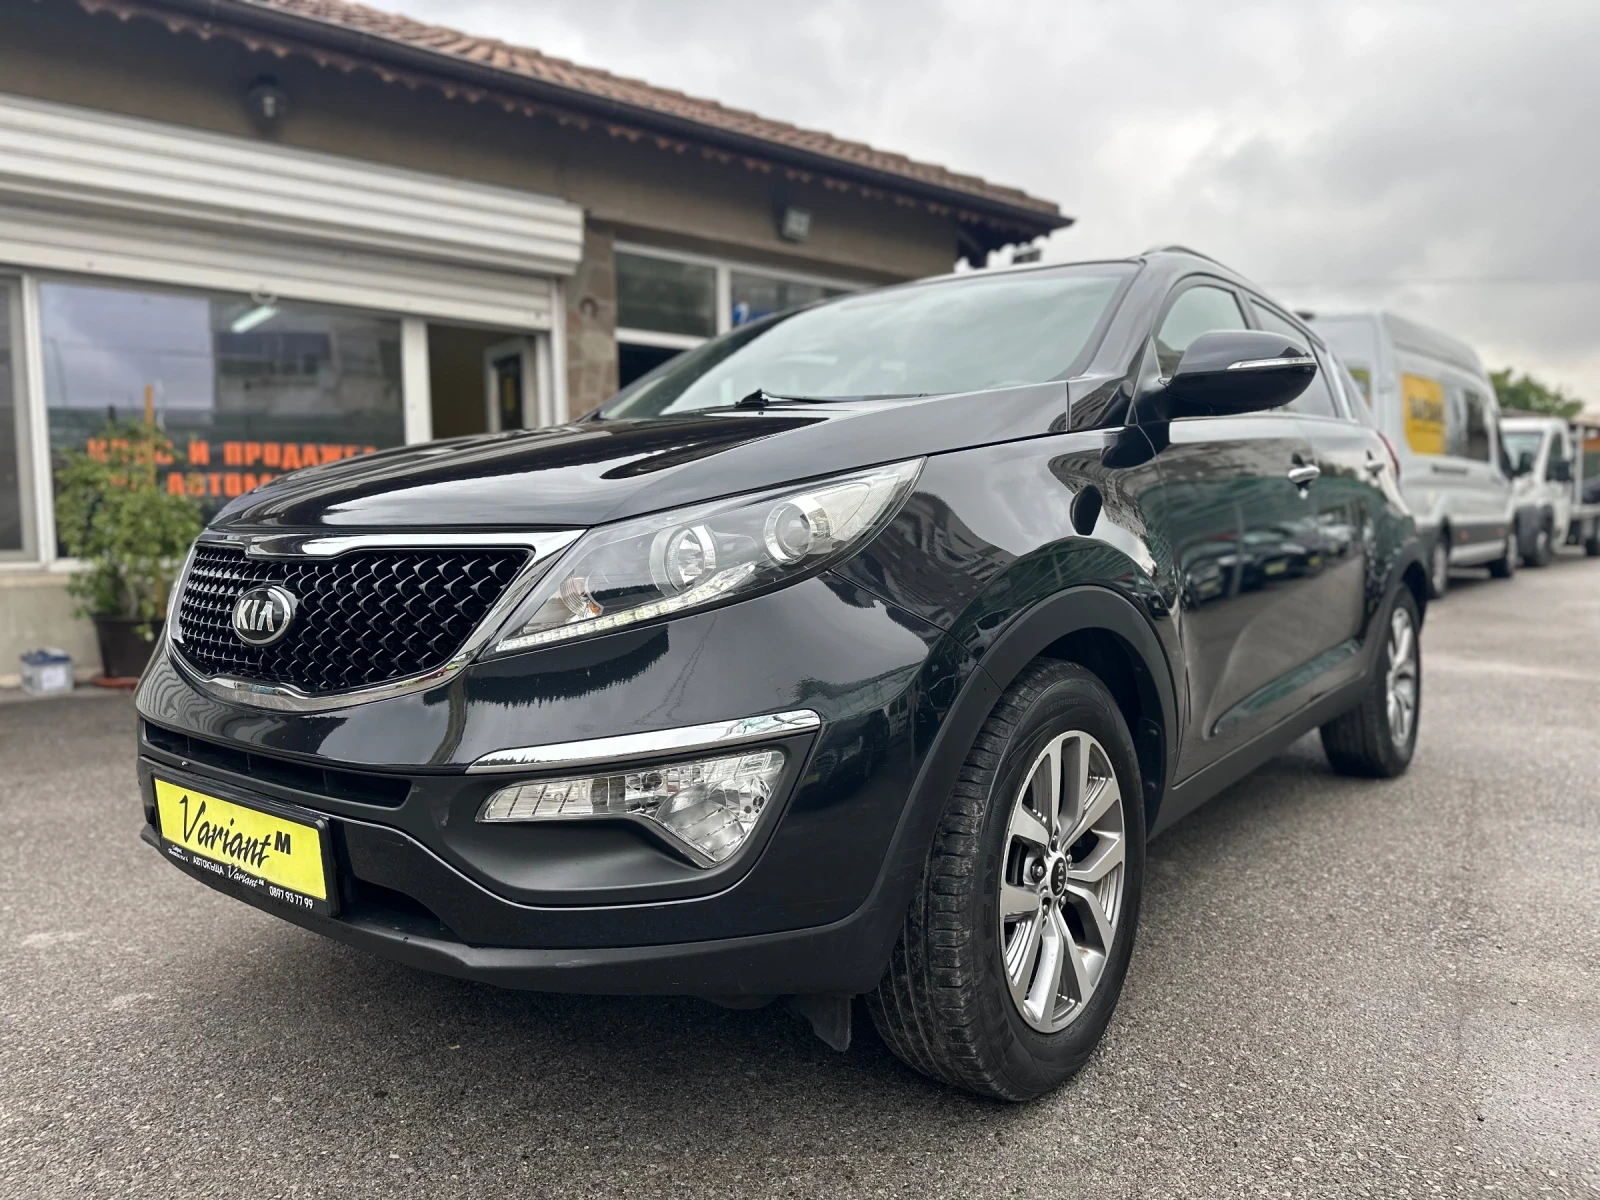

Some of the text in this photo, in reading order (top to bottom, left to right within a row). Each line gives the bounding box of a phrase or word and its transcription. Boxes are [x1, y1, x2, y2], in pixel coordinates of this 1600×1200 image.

[236, 599, 275, 632] KIA
[179, 794, 271, 868] Variant
[1056, 862, 1065, 892] KIA
[269, 885, 284, 899] 0897
[285, 891, 294, 903] 93
[294, 894, 303, 906] 77
[304, 897, 314, 910] 99
